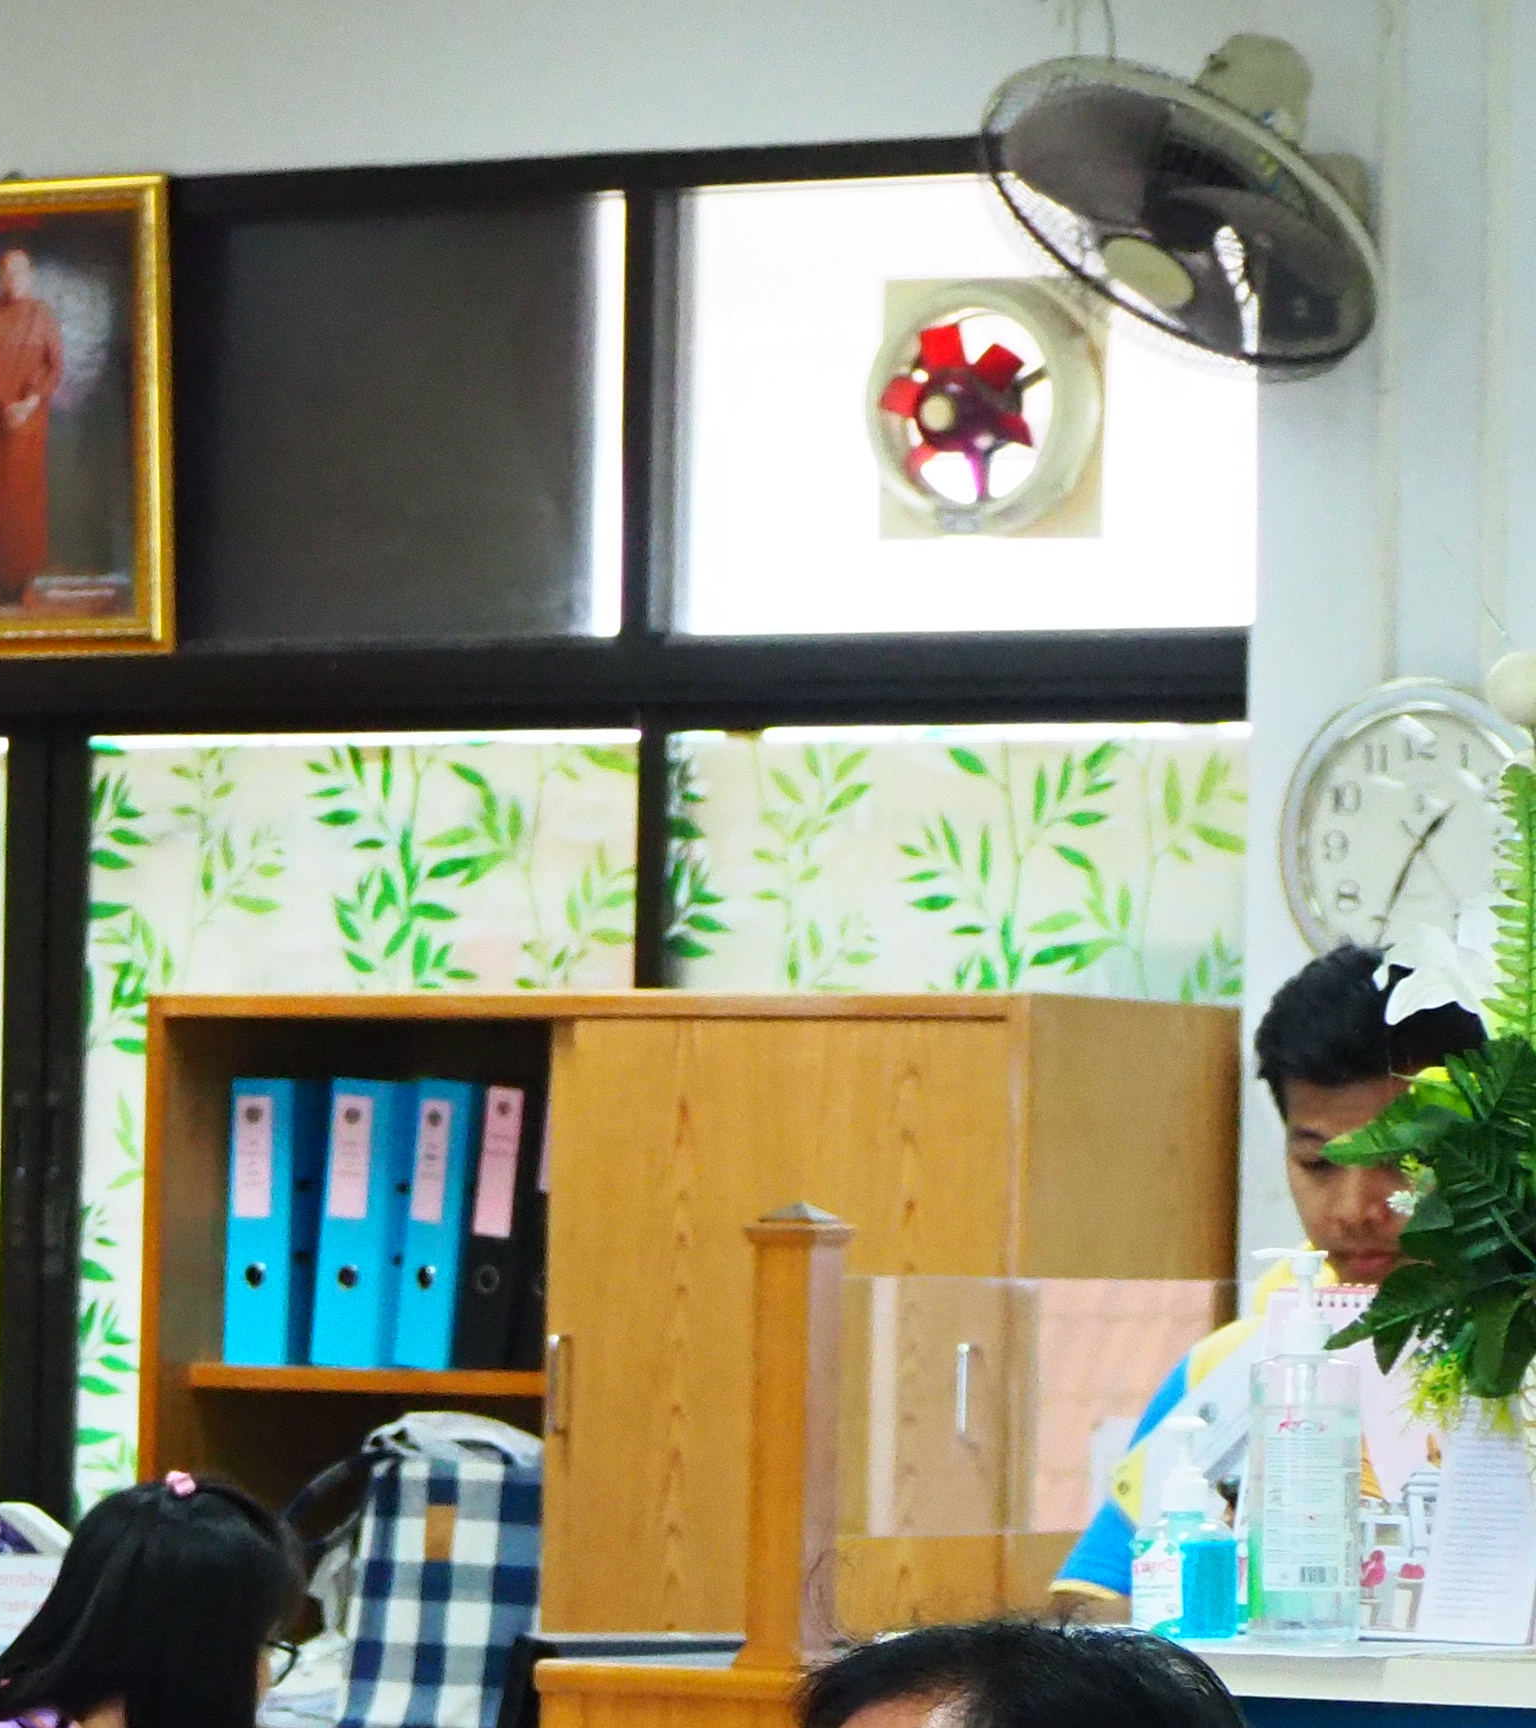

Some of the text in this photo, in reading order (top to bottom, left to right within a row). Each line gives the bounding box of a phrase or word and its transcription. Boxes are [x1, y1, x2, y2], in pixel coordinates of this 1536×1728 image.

[1332, 780, 1362, 814] 10
[1323, 829, 1349, 863] 9
[1337, 879, 1361, 913] 8
